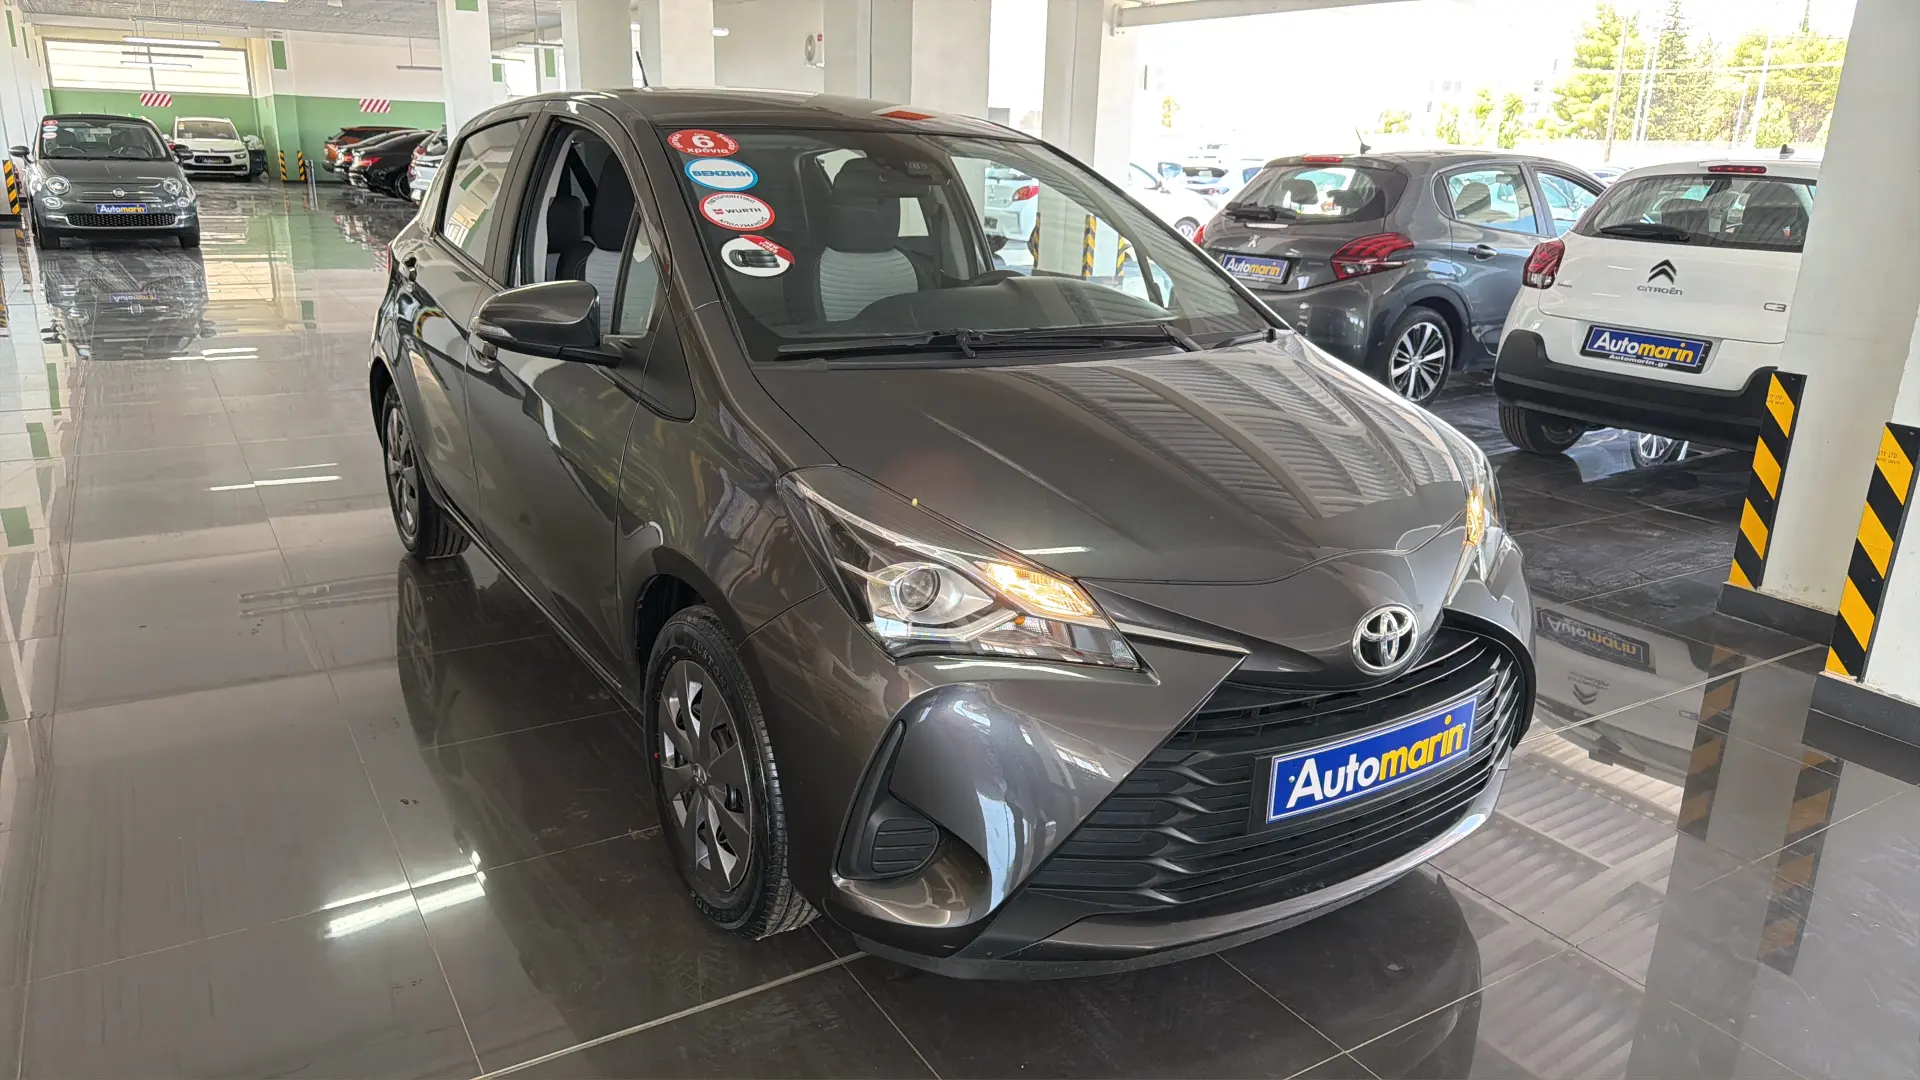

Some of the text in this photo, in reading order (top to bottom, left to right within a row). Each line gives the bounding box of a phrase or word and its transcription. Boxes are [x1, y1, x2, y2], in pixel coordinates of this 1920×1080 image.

[692, 135, 715, 148] 6
[691, 170, 752, 178] ΒΕΝΖΙΝΗ
[99, 204, 145, 213] Automarin
[1225, 257, 1281, 276] Automarin
[1763, 302, 1787, 313] C3
[1593, 331, 1694, 364] Automarin
[1608, 354, 1669, 368] Automarin.gr
[1285, 715, 1464, 809] Automarin
